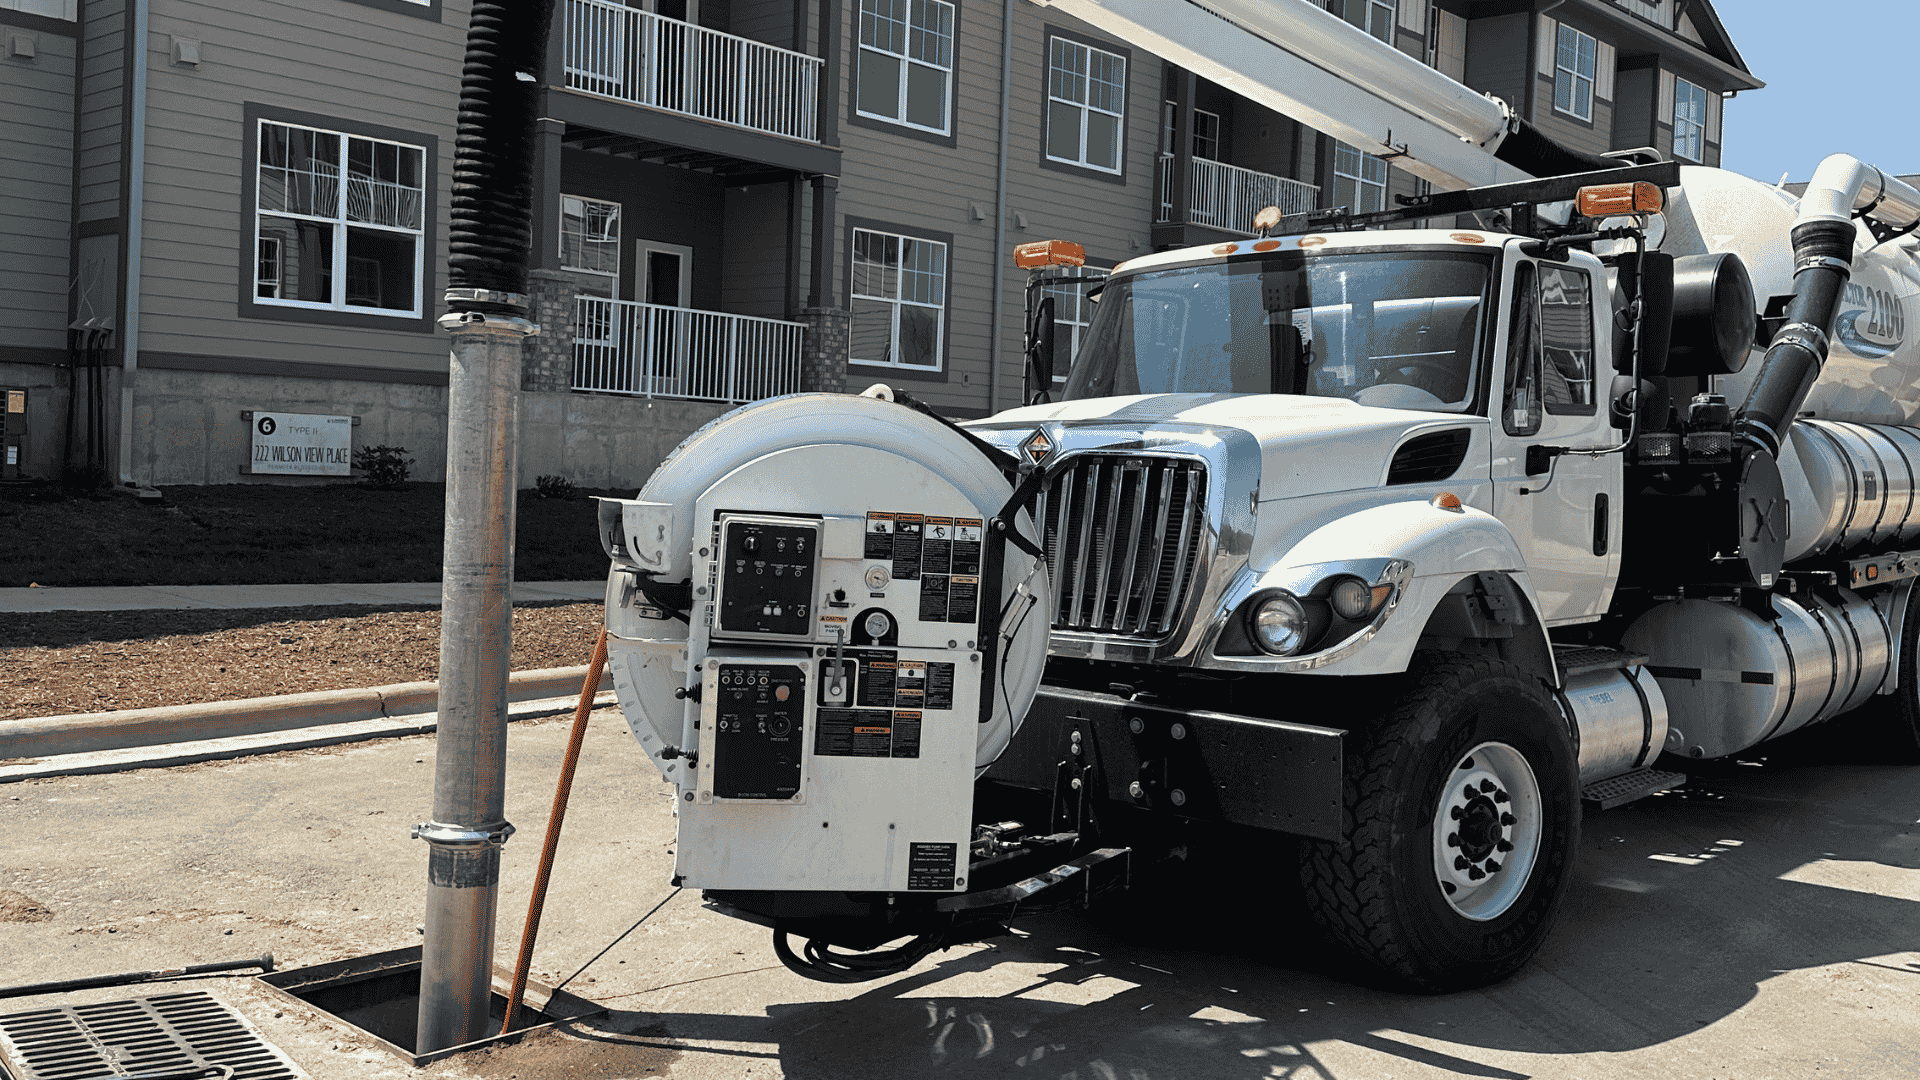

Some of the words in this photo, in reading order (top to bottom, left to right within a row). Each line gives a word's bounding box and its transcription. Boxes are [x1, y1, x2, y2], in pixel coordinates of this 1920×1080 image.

[1866, 286, 1904, 340] 2100
[262, 420, 271, 432] 6
[288, 426, 311, 435] TYPE
[255, 445, 270, 462] 222
[272, 445, 302, 463] WILSON
[304, 447, 324, 463] VIEW
[326, 448, 348, 464] PLACE
